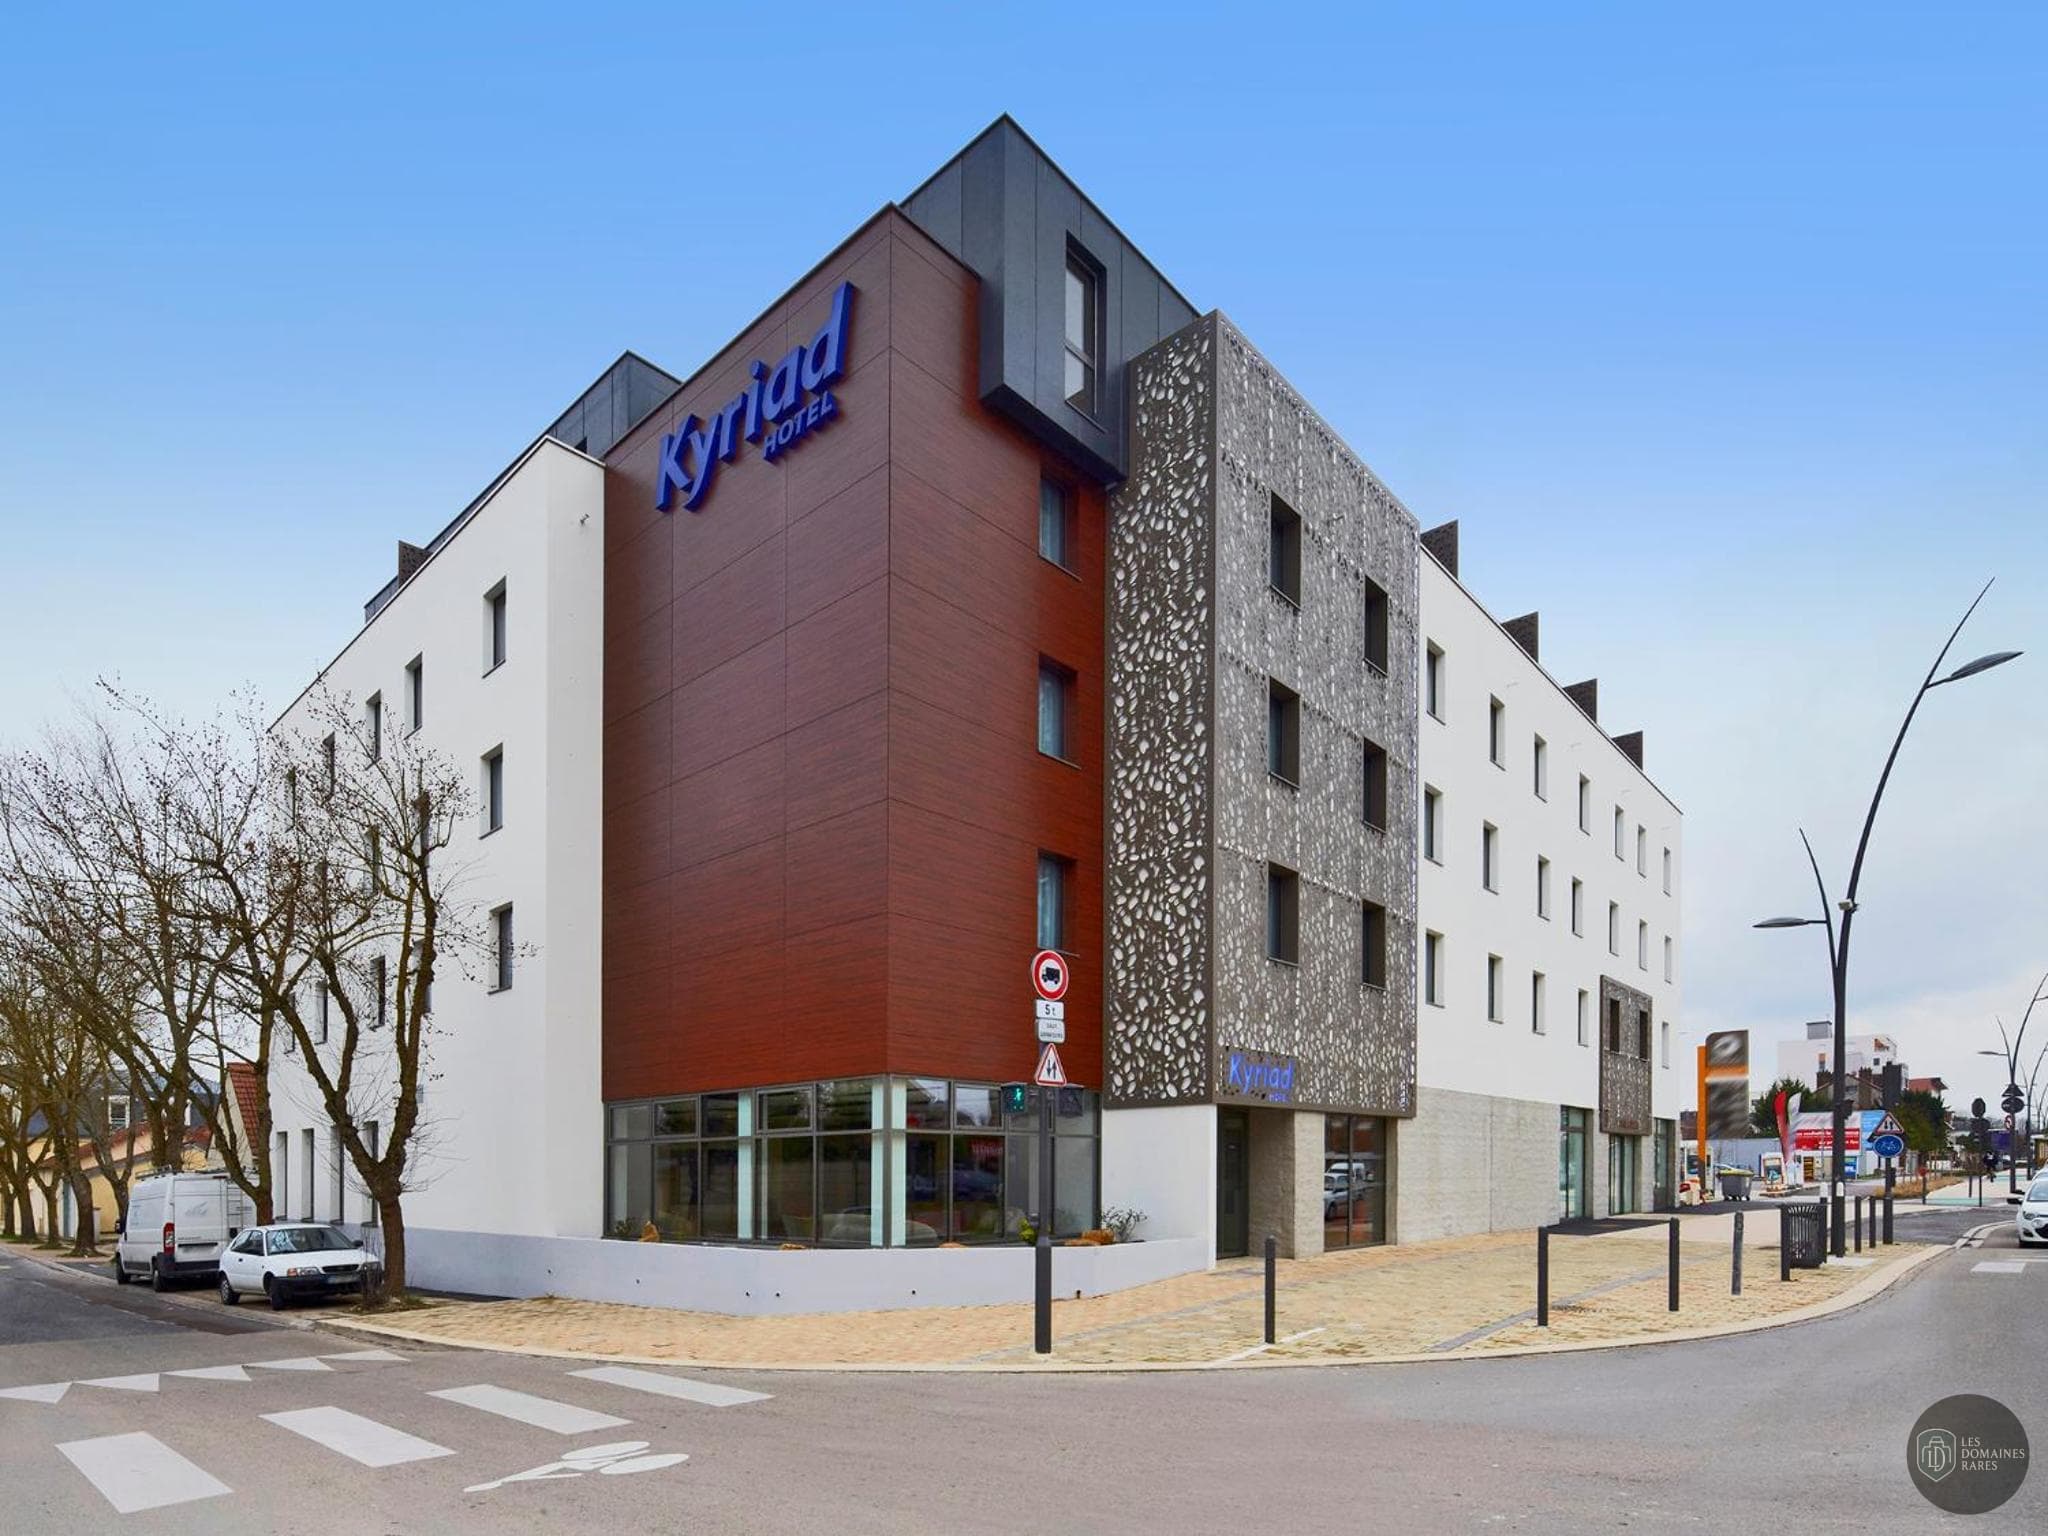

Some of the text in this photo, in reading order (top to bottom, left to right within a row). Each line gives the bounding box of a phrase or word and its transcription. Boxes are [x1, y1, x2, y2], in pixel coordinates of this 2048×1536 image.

[655, 281, 857, 512] Kyriad
[763, 391, 839, 462] HOTEL
[1229, 1052, 1294, 1095] Kyriad
